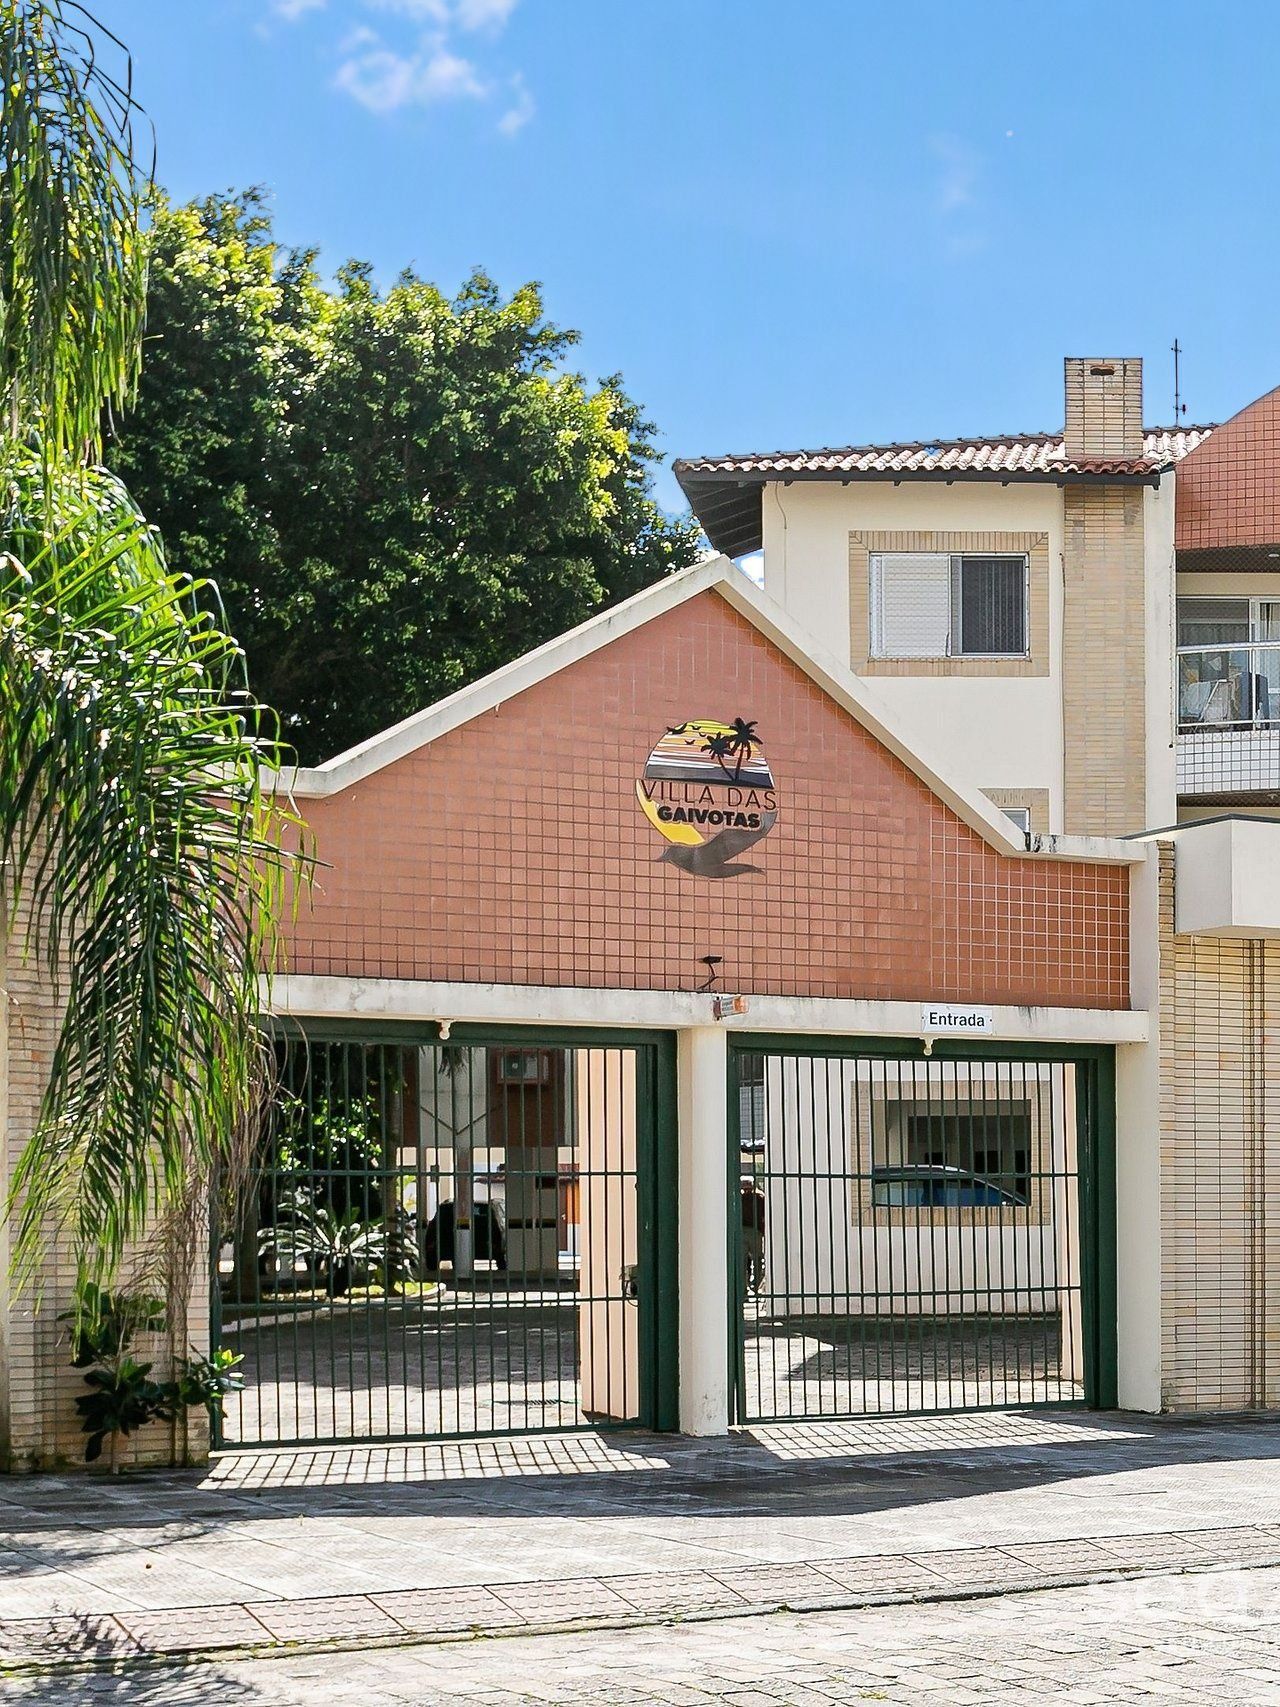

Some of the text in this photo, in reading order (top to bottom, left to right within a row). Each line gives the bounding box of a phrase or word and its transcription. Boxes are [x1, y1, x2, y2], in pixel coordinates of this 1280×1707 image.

[641, 780, 777, 811] VILLA DAS
[657, 806, 760, 828] GAIVOTAS
[929, 1011, 985, 1027] Entrada
